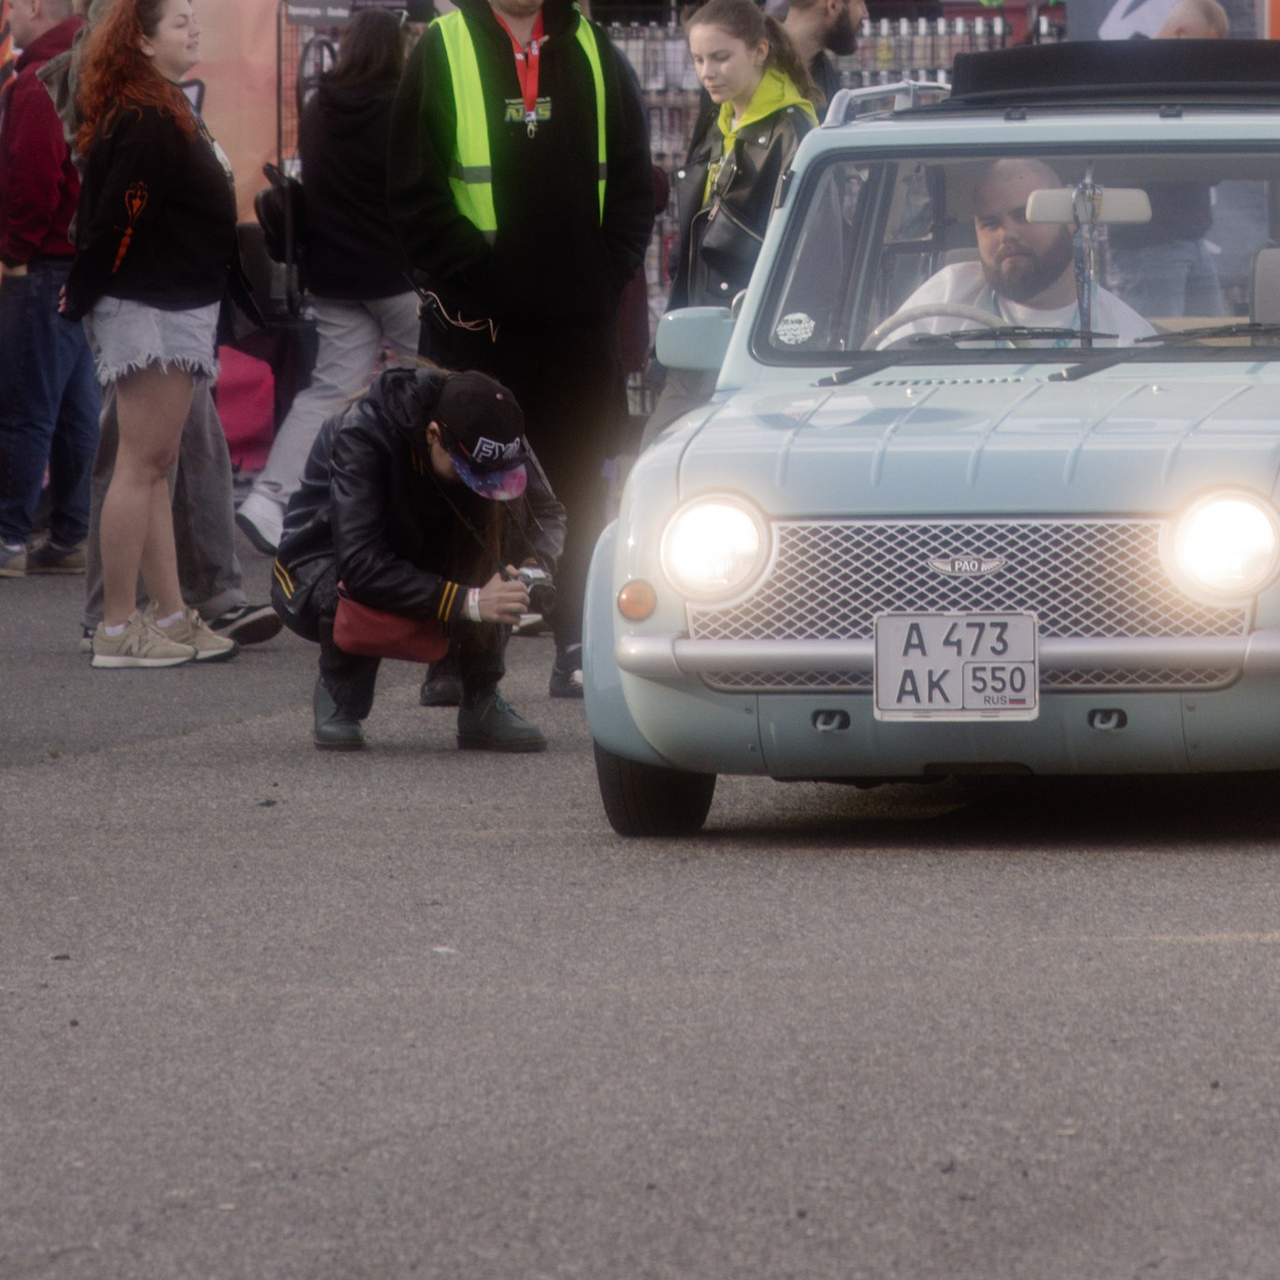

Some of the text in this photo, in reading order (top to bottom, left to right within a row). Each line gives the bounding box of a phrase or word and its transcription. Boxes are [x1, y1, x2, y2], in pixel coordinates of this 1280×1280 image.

[954, 560, 979, 572] PAO
[902, 622, 1009, 657] A 473
[896, 666, 1026, 704] AK 550
[983, 695, 1008, 706] RUS
